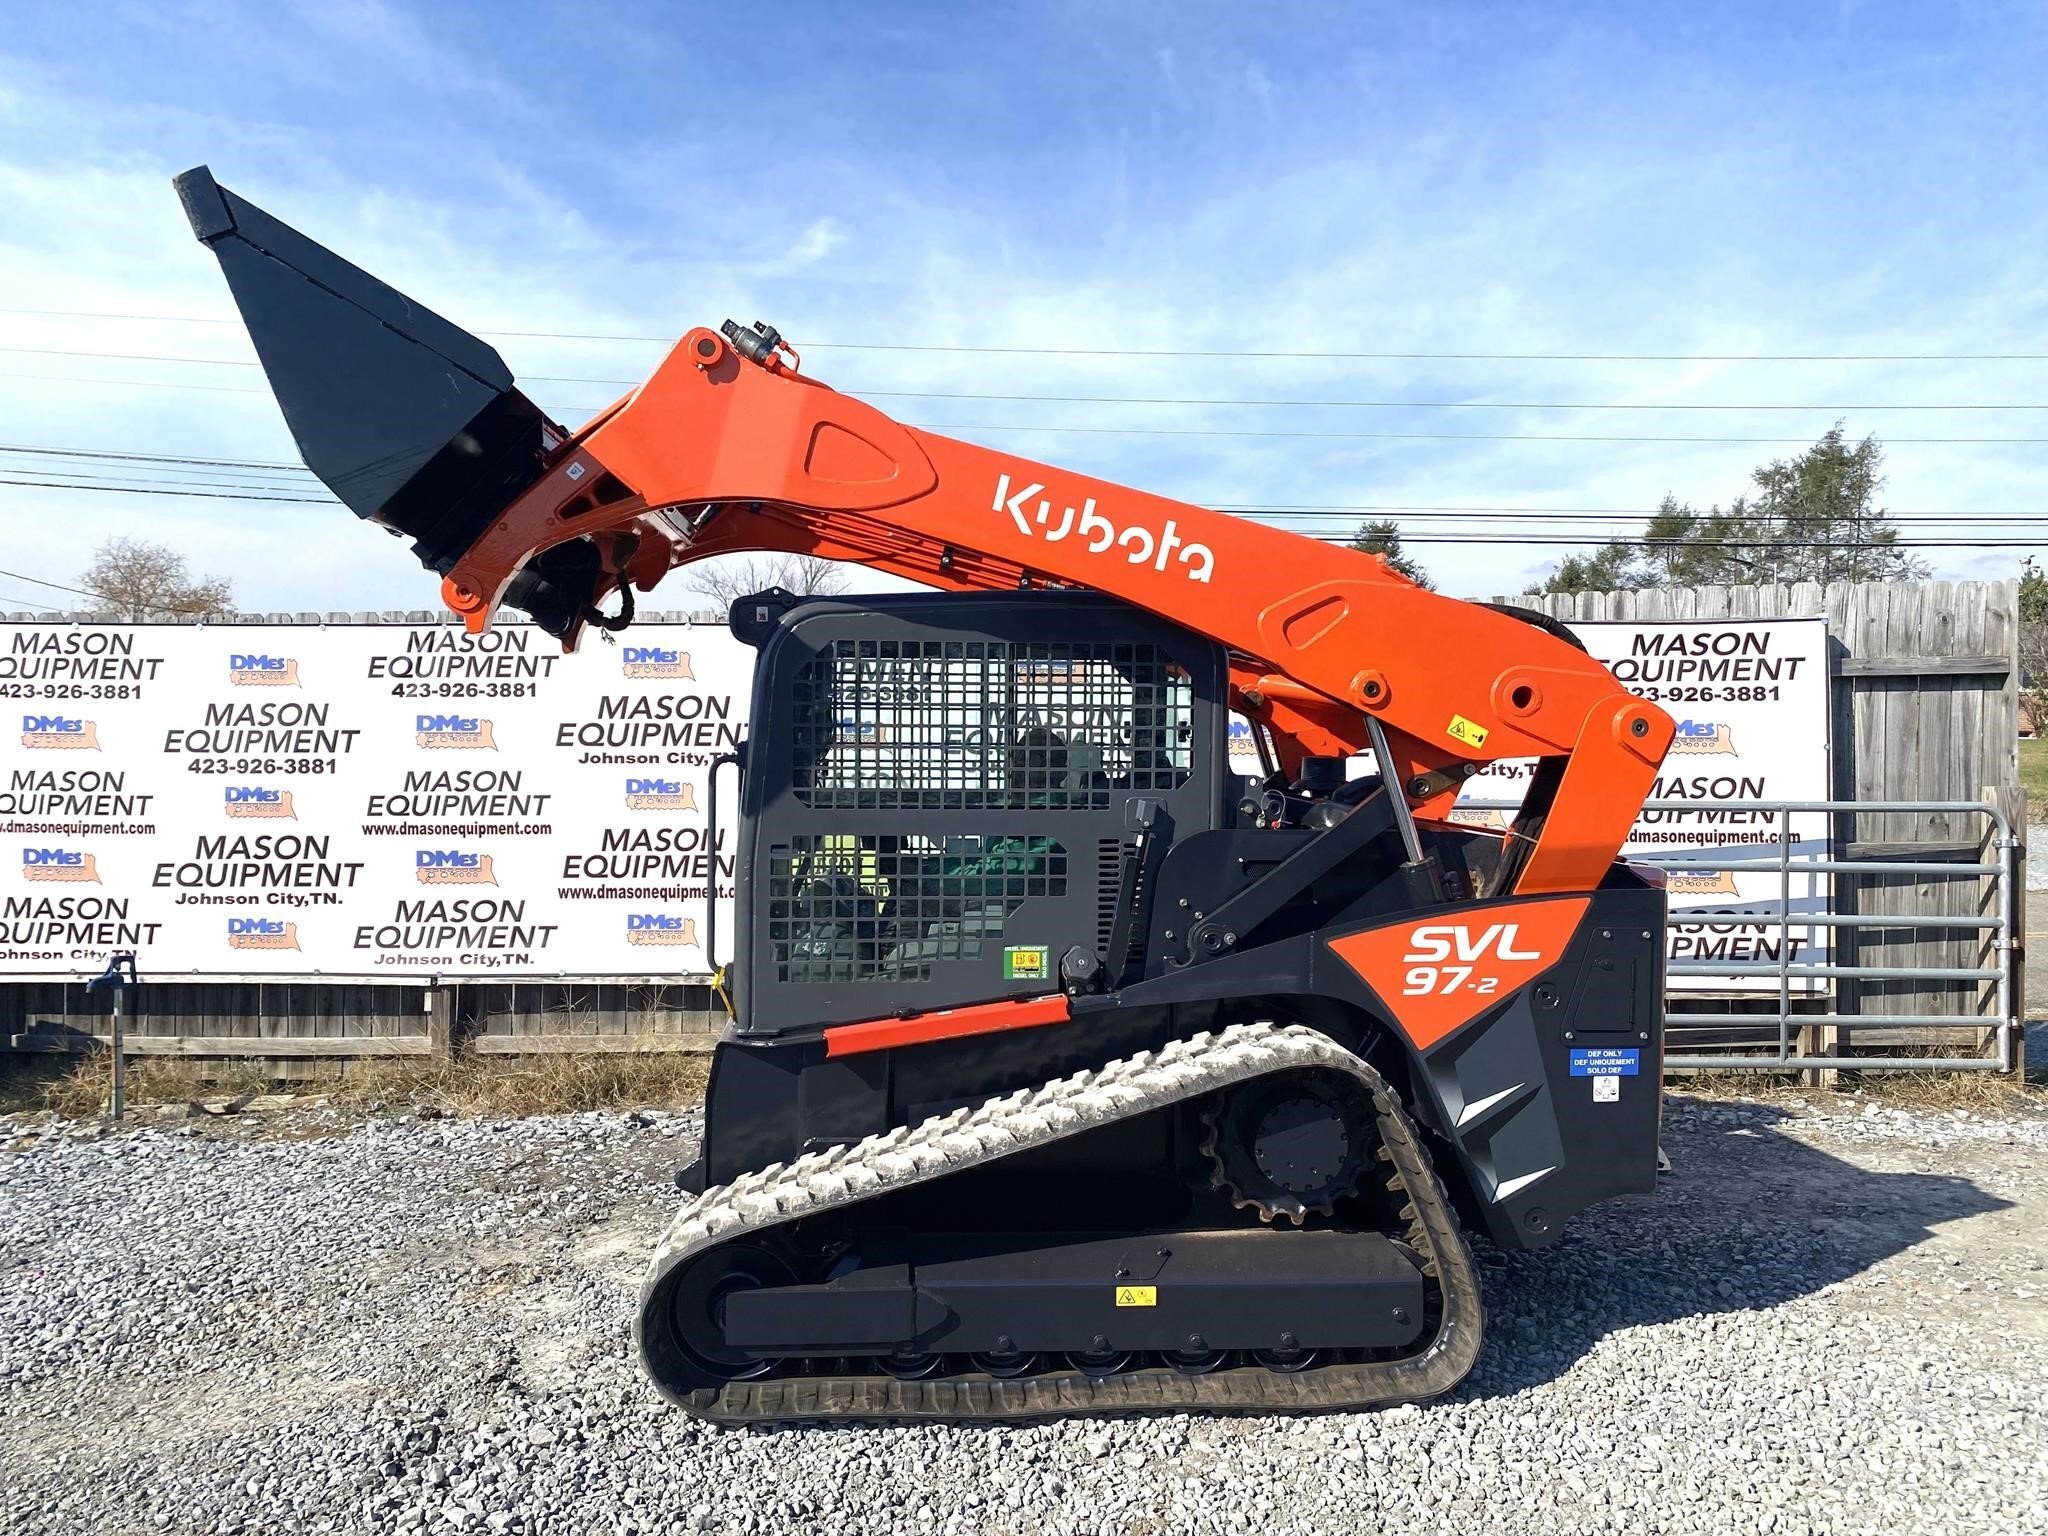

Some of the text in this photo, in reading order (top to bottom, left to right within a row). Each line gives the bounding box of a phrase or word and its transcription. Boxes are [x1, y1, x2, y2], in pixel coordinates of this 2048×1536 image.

[991, 473, 1215, 584] Kubota
[12, 633, 133, 655] MASON
[407, 631, 527, 652] MASON
[1632, 632, 1770, 656] MASON
[0, 657, 164, 680] QUIPMENT
[368, 656, 559, 678] EQUIPMENT
[1601, 657, 1805, 682] QUIPMENT
[0, 684, 140, 699] 423-926-3881
[392, 683, 535, 697] 423-926-3881
[1620, 686, 1779, 701] 23-926-3881
[205, 703, 329, 726] MASON
[598, 696, 730, 719] MASON
[164, 730, 360, 753] EQUIPMENT
[556, 723, 749, 746] EQUIPMEN
[188, 759, 335, 774] 423-926-3881
[579, 753, 659, 763] Johnson
[11, 771, 124, 792] MASON
[404, 771, 521, 792] MASON
[0, 794, 153, 815] QUIPMENT
[367, 795, 551, 816] EQUIPMENT
[362, 822, 551, 838] www.dmasonequipment.com
[602, 828, 724, 851] MASON
[196, 836, 329, 859] MASON
[152, 863, 364, 887] EQUIPMENT
[563, 855, 734, 878] EQUIPMEN
[3, 897, 128, 919] MASON
[175, 893, 342, 907] Johnson City,TN.
[395, 900, 525, 922] MASON
[0, 922, 162, 944] QUIPMENT
[354, 926, 558, 948] EQUIPMENT
[1402, 924, 1541, 963] SVL
[0, 949, 63, 959] ohnson
[375, 954, 534, 968] Johnson City,TN.
[1402, 966, 1499, 996] 97-2
